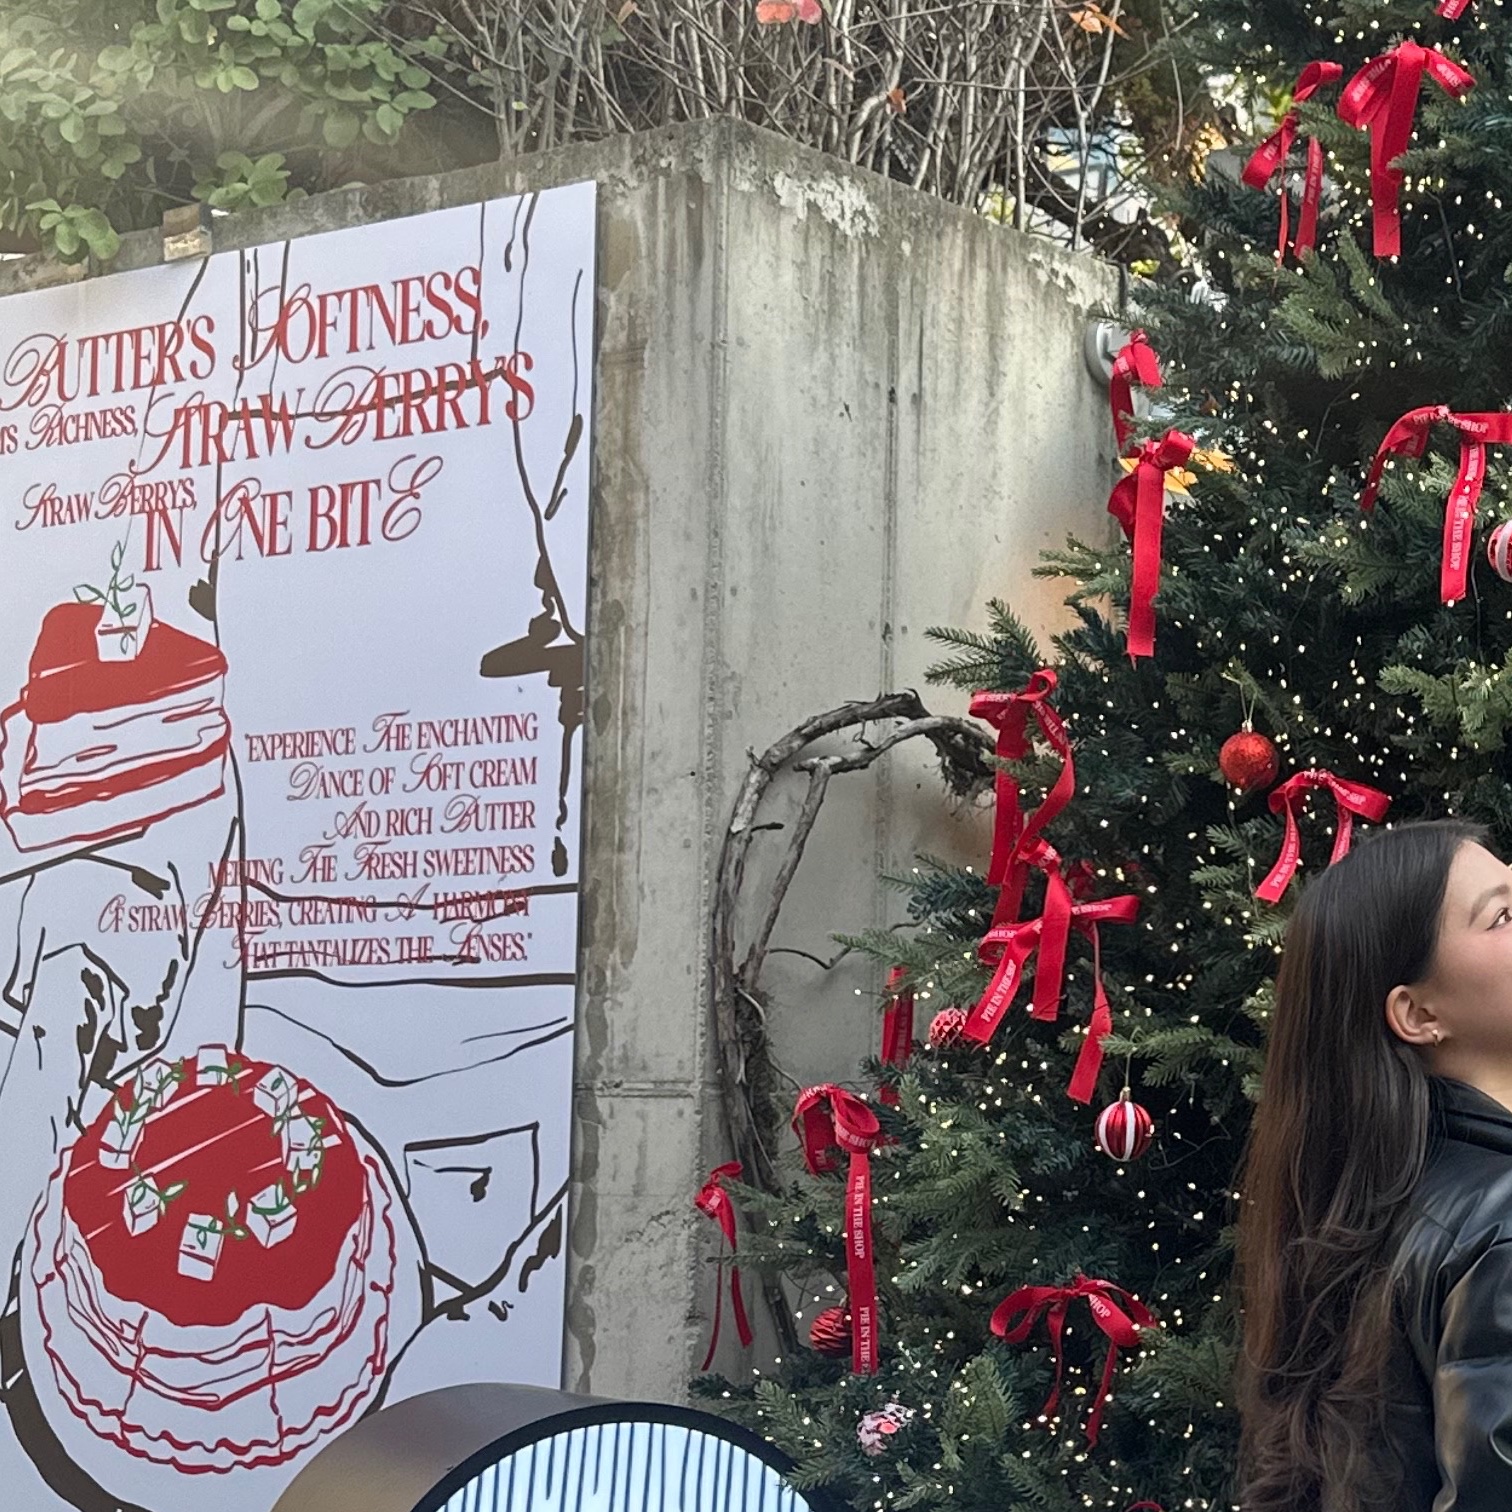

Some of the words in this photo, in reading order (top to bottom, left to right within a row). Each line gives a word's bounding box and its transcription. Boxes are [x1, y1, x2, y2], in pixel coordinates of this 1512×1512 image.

[0, 315, 215, 411] BUTTER'S
[25, 403, 138, 450] RICHNESS,
[143, 507, 184, 572] IN
[363, 710, 412, 753] THE
[417, 713, 538, 749] ENCHANTING
[287, 761, 364, 801] DANCE
[369, 767, 396, 795] OF
[403, 752, 465, 792] SOFT
[469, 757, 537, 789] CREAM
[323, 801, 380, 840] AND
[386, 807, 432, 836] RICH
[441, 794, 535, 833] BUTTER
[291, 841, 337, 884] THE
[345, 840, 418, 881] FRESH
[423, 844, 535, 878] SWEETNESS
[98, 894, 126, 933] OF
[288, 895, 377, 925] CREATING
[285, 937, 390, 968] TANTALIZES
[395, 936, 434, 965] THE
[980, 1002, 997, 1022] PIE
[989, 991, 1003, 1005] IN
[854, 1176, 863, 1190] PIE
[854, 1192, 864, 1204] IN
[853, 1206, 863, 1227] THE
[853, 1229, 864, 1258] SHOP
[860, 1307, 869, 1324] PIE
[860, 1326, 869, 1337] IN
[860, 1340, 869, 1361] THE
